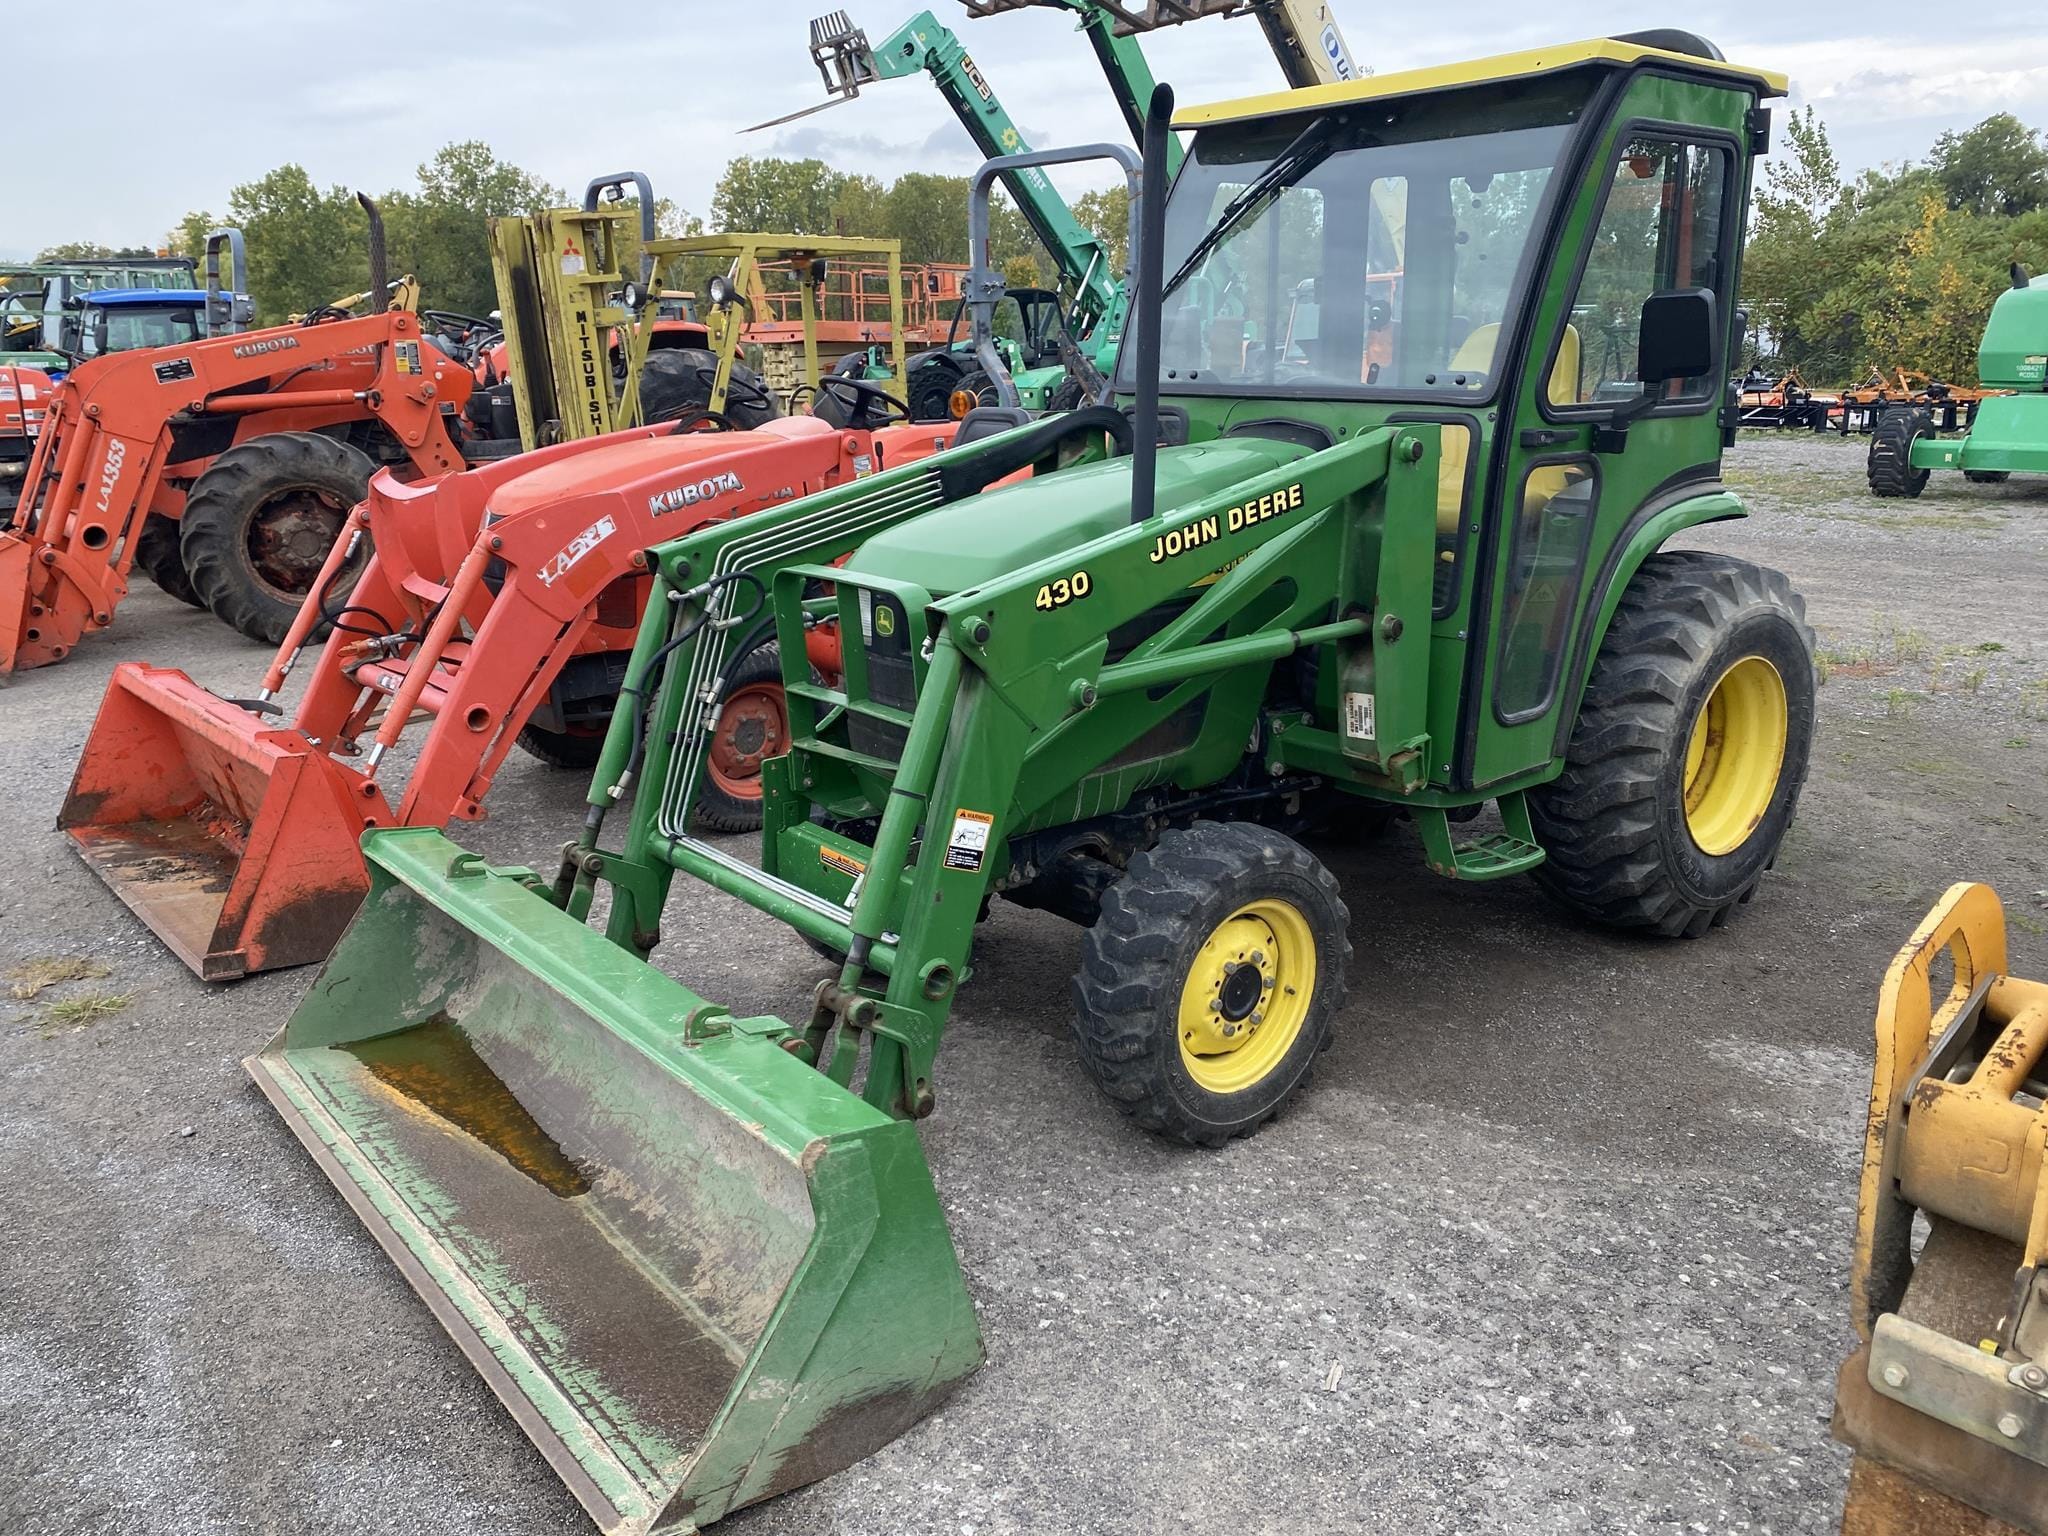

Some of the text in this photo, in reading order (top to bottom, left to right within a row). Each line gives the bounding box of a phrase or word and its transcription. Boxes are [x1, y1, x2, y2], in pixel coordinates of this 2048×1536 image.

[959, 54, 993, 102] JCB
[233, 335, 299, 358] KUBOTA
[575, 310, 603, 436] MITSUBISHI
[96, 438, 126, 513] LA1353
[649, 470, 745, 518] KUBOTA
[1149, 514, 1221, 564] JOHN
[1227, 483, 1304, 534] DEERE
[1035, 570, 1093, 612] 430
